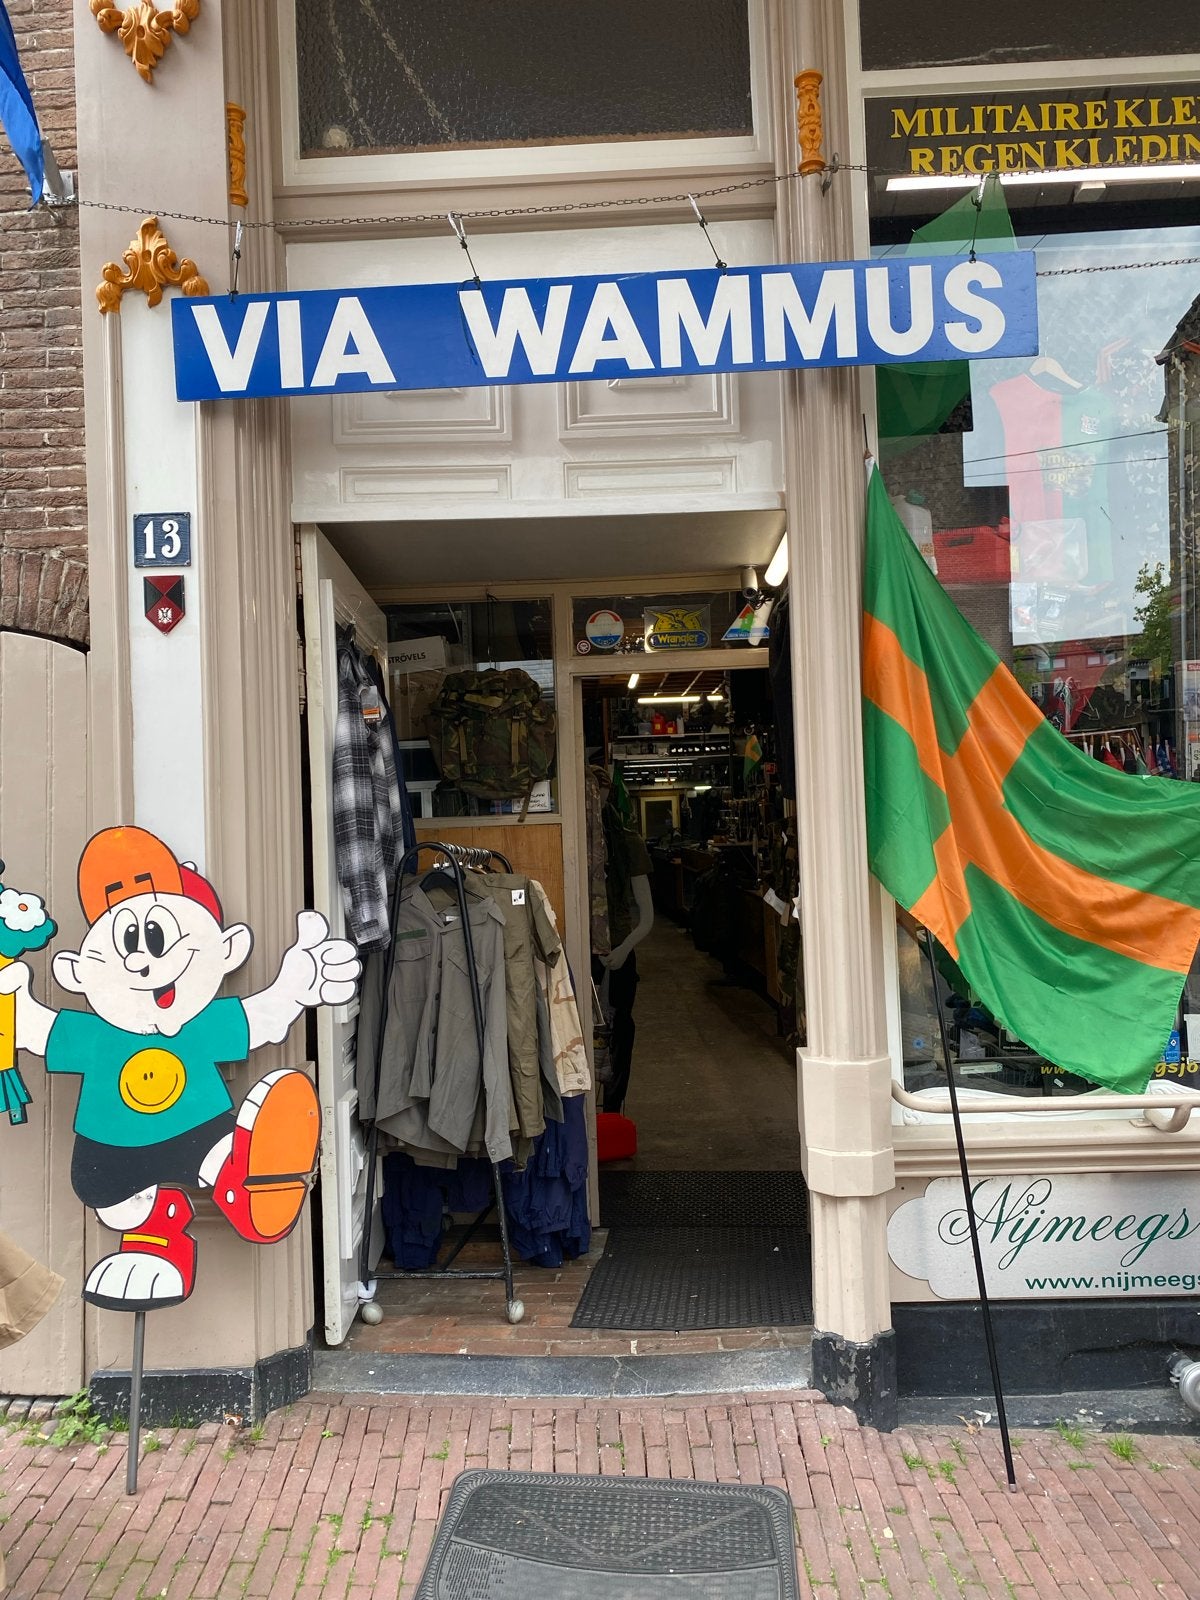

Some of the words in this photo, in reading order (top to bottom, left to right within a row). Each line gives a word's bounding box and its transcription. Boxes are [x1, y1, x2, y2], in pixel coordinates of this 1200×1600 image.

[1113, 96, 1200, 129] KLE
[191, 297, 397, 392] VIA
[458, 259, 1006, 378] WAMMUS
[143, 519, 182, 559] 13
[657, 634, 698, 646] Wrangler
[1025, 1271, 1200, 1292] www.nijmeeg
